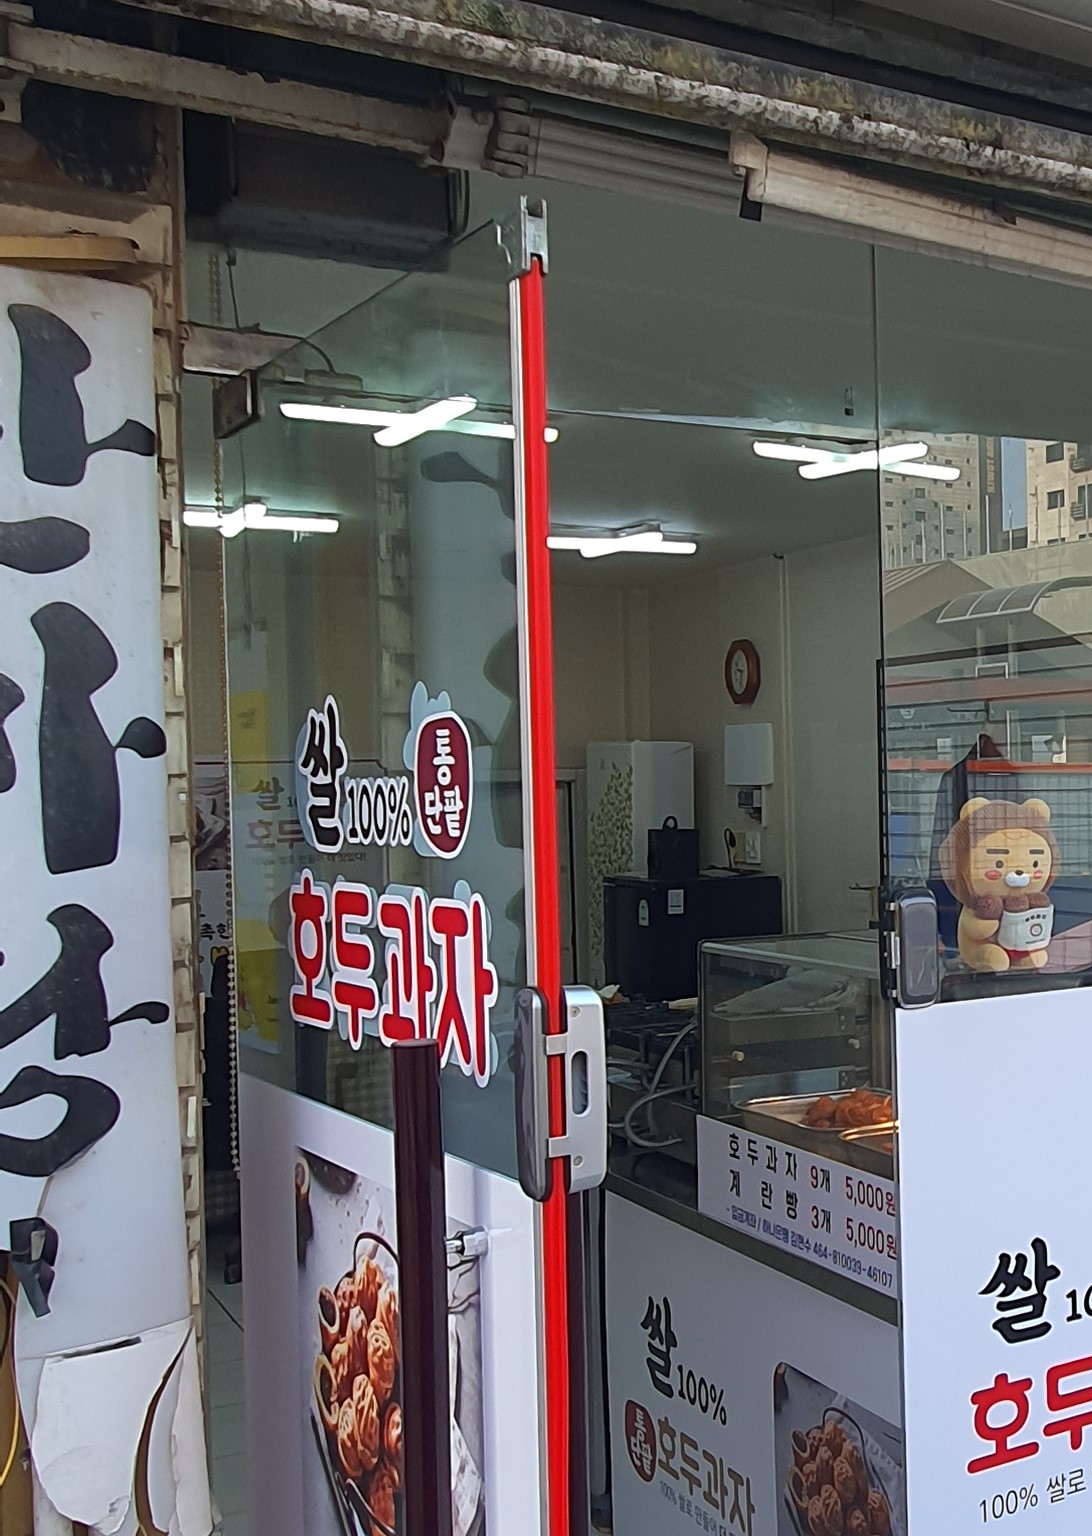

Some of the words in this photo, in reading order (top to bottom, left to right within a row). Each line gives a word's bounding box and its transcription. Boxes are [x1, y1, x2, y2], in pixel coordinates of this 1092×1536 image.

[300, 700, 345, 848] 쌀
[346, 778, 411, 847] 100%
[290, 872, 497, 1086] 호두과자
[728, 1132, 798, 1182] 호두과자
[809, 1165, 832, 1195] 9개
[845, 1176, 897, 1218] 5,000원
[728, 1169, 798, 1219] 계란빵
[811, 1205, 832, 1235] 3개
[845, 1217, 897, 1262] 5,000원
[976, 1235, 1062, 1346] 쌀
[640, 1295, 678, 1400] 쌀
[678, 1363, 727, 1426] 100%
[977, 1482, 1039, 1524] 100%
[1045, 1467, 1089, 1505] 쌀로
